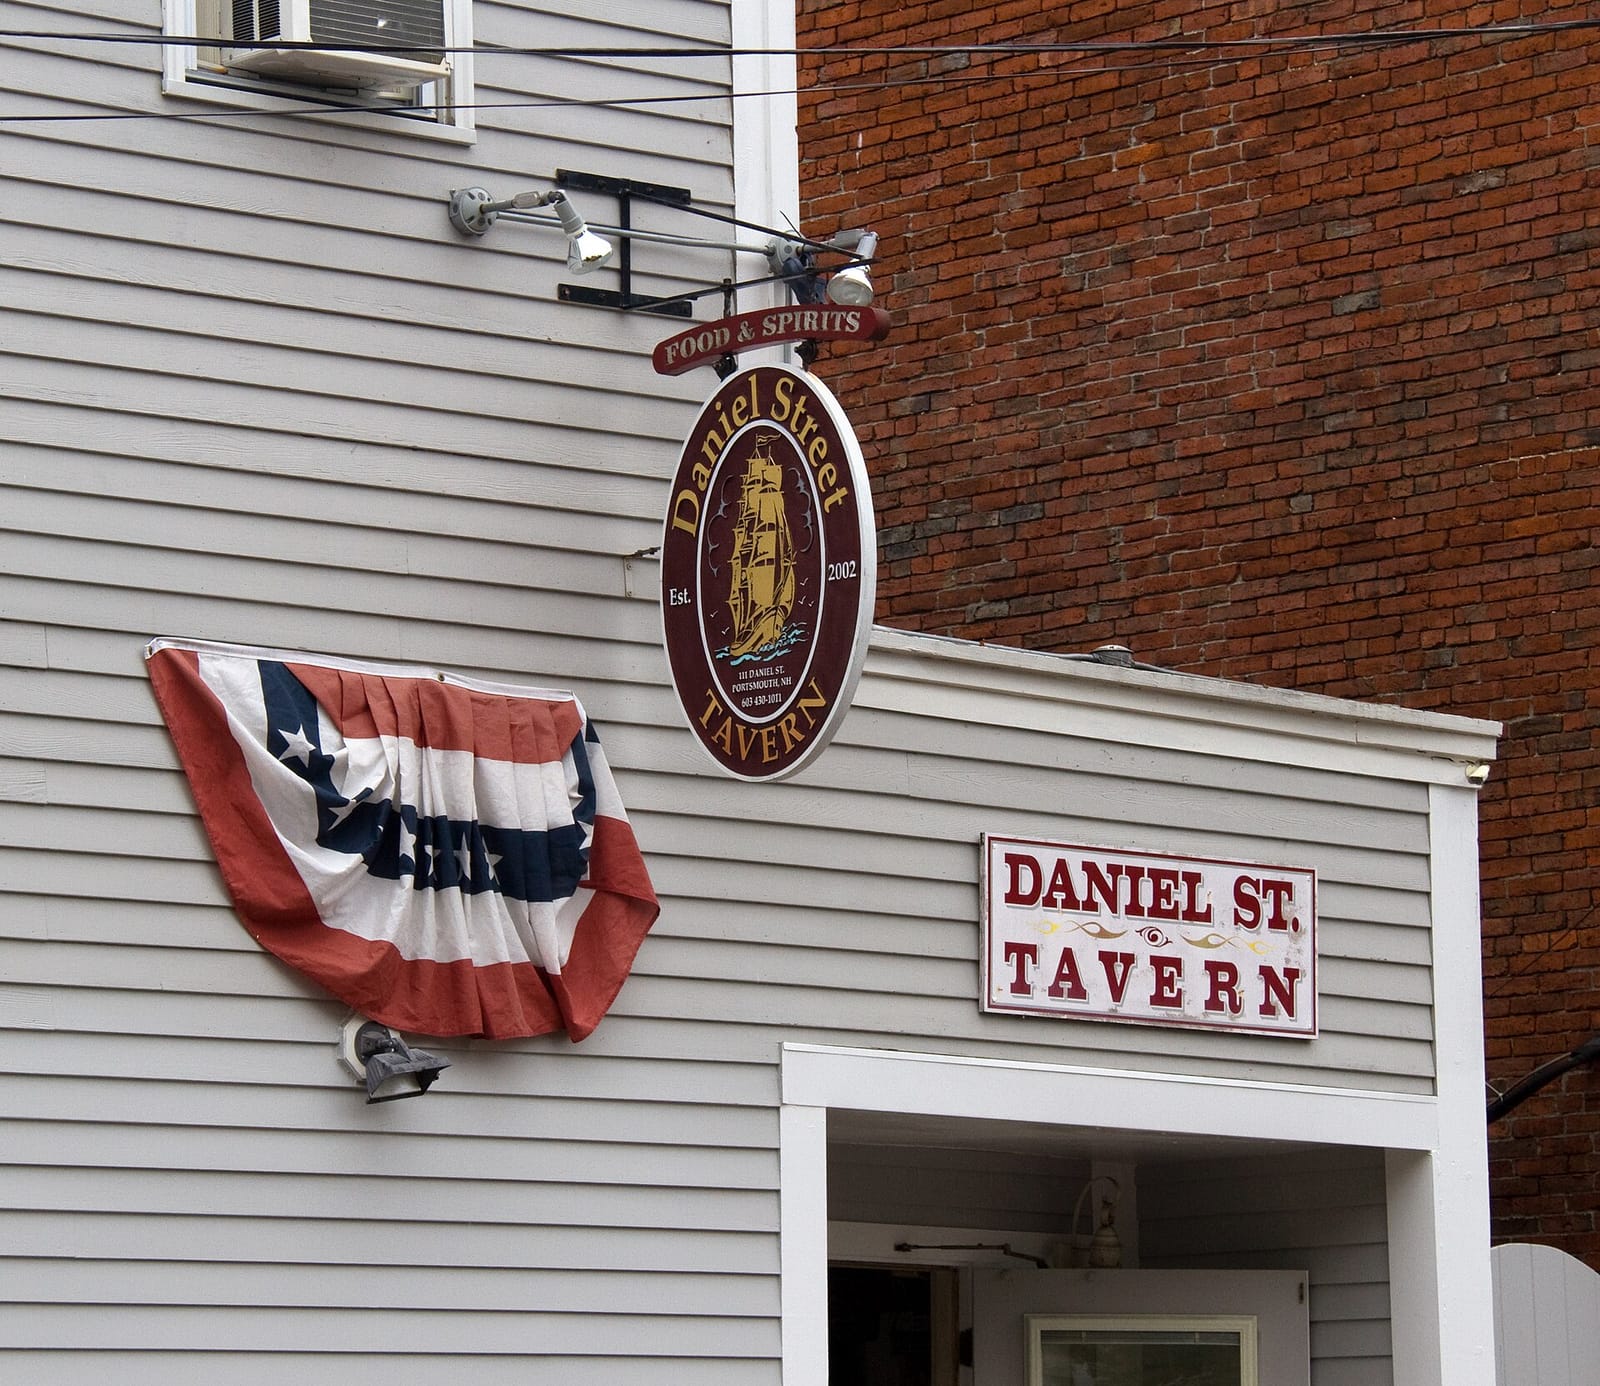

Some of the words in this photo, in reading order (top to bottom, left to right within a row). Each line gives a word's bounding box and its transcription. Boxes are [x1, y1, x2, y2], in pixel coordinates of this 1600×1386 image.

[665, 328, 730, 365] FOOD
[737, 320, 755, 343] &
[762, 311, 861, 337] SPIRITS
[672, 373, 761, 538] Daniel
[770, 377, 849, 514] Street
[669, 588, 691, 606] Est.
[827, 560, 857, 581] 2002
[732, 679, 780, 693] PORTSMOUTH,
[781, 676, 792, 686] NH
[739, 671, 748, 680] 111
[749, 667, 774, 678] DANIEL
[775, 665, 785, 675] ST.
[699, 676, 827, 764] TAVERN
[741, 697, 753, 708] 603
[754, 693, 782, 706] 430-1011
[1004, 852, 1213, 925] DANIEL
[1233, 875, 1300, 932] ST.
[1004, 941, 1300, 1019] TAVERN
